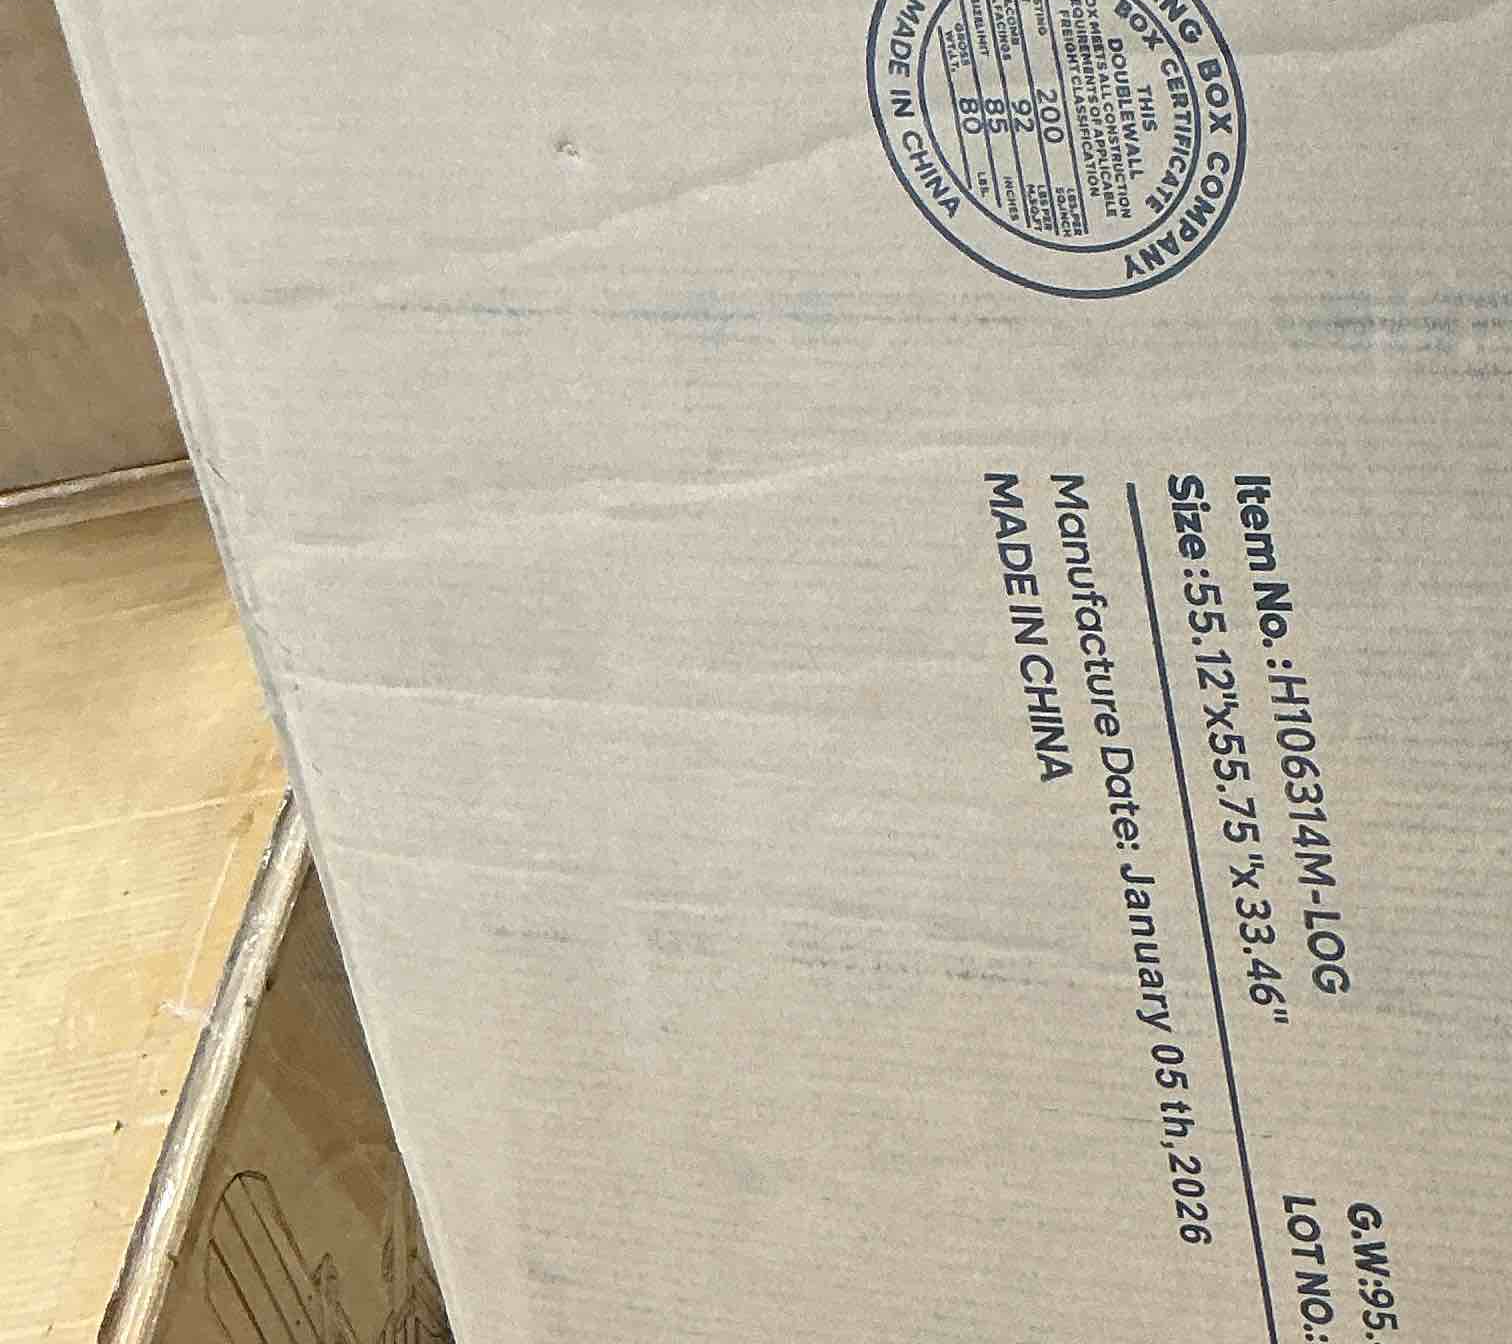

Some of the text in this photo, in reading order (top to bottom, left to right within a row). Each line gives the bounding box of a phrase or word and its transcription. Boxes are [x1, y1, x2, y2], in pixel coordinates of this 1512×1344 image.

[890, 87, 915, 118] IN
[958, 97, 984, 135] 80
[981, 97, 1009, 135] 85
[1010, 98, 1035, 133] 92
[1036, 88, 1065, 144] 200
[1098, 73, 1113, 100] ALL
[1107, 37, 1145, 181] DOUBLEWALL
[1114, 0, 1193, 214] BOX CERTIFICATE
[1136, 83, 1159, 132] THIS
[1197, 58, 1233, 134] BOX
[901, 130, 962, 219] CHINA
[1070, 75, 1101, 198] CLASSIFICATION
[1093, 128, 1118, 218] APPLICABLE
[1102, 101, 1133, 219] CONSTRUCTION
[1002, 175, 1020, 222] INCHES
[1125, 152, 1230, 280] COMPANY
[1233, 475, 1277, 572] Item
[983, 472, 1074, 784] MADE IN CHINA
[1049, 474, 1121, 738] Manufacture
[1099, 746, 1142, 851] Date:
[1119, 862, 1173, 1034] January
[1281, 1194, 1326, 1266] LOT
